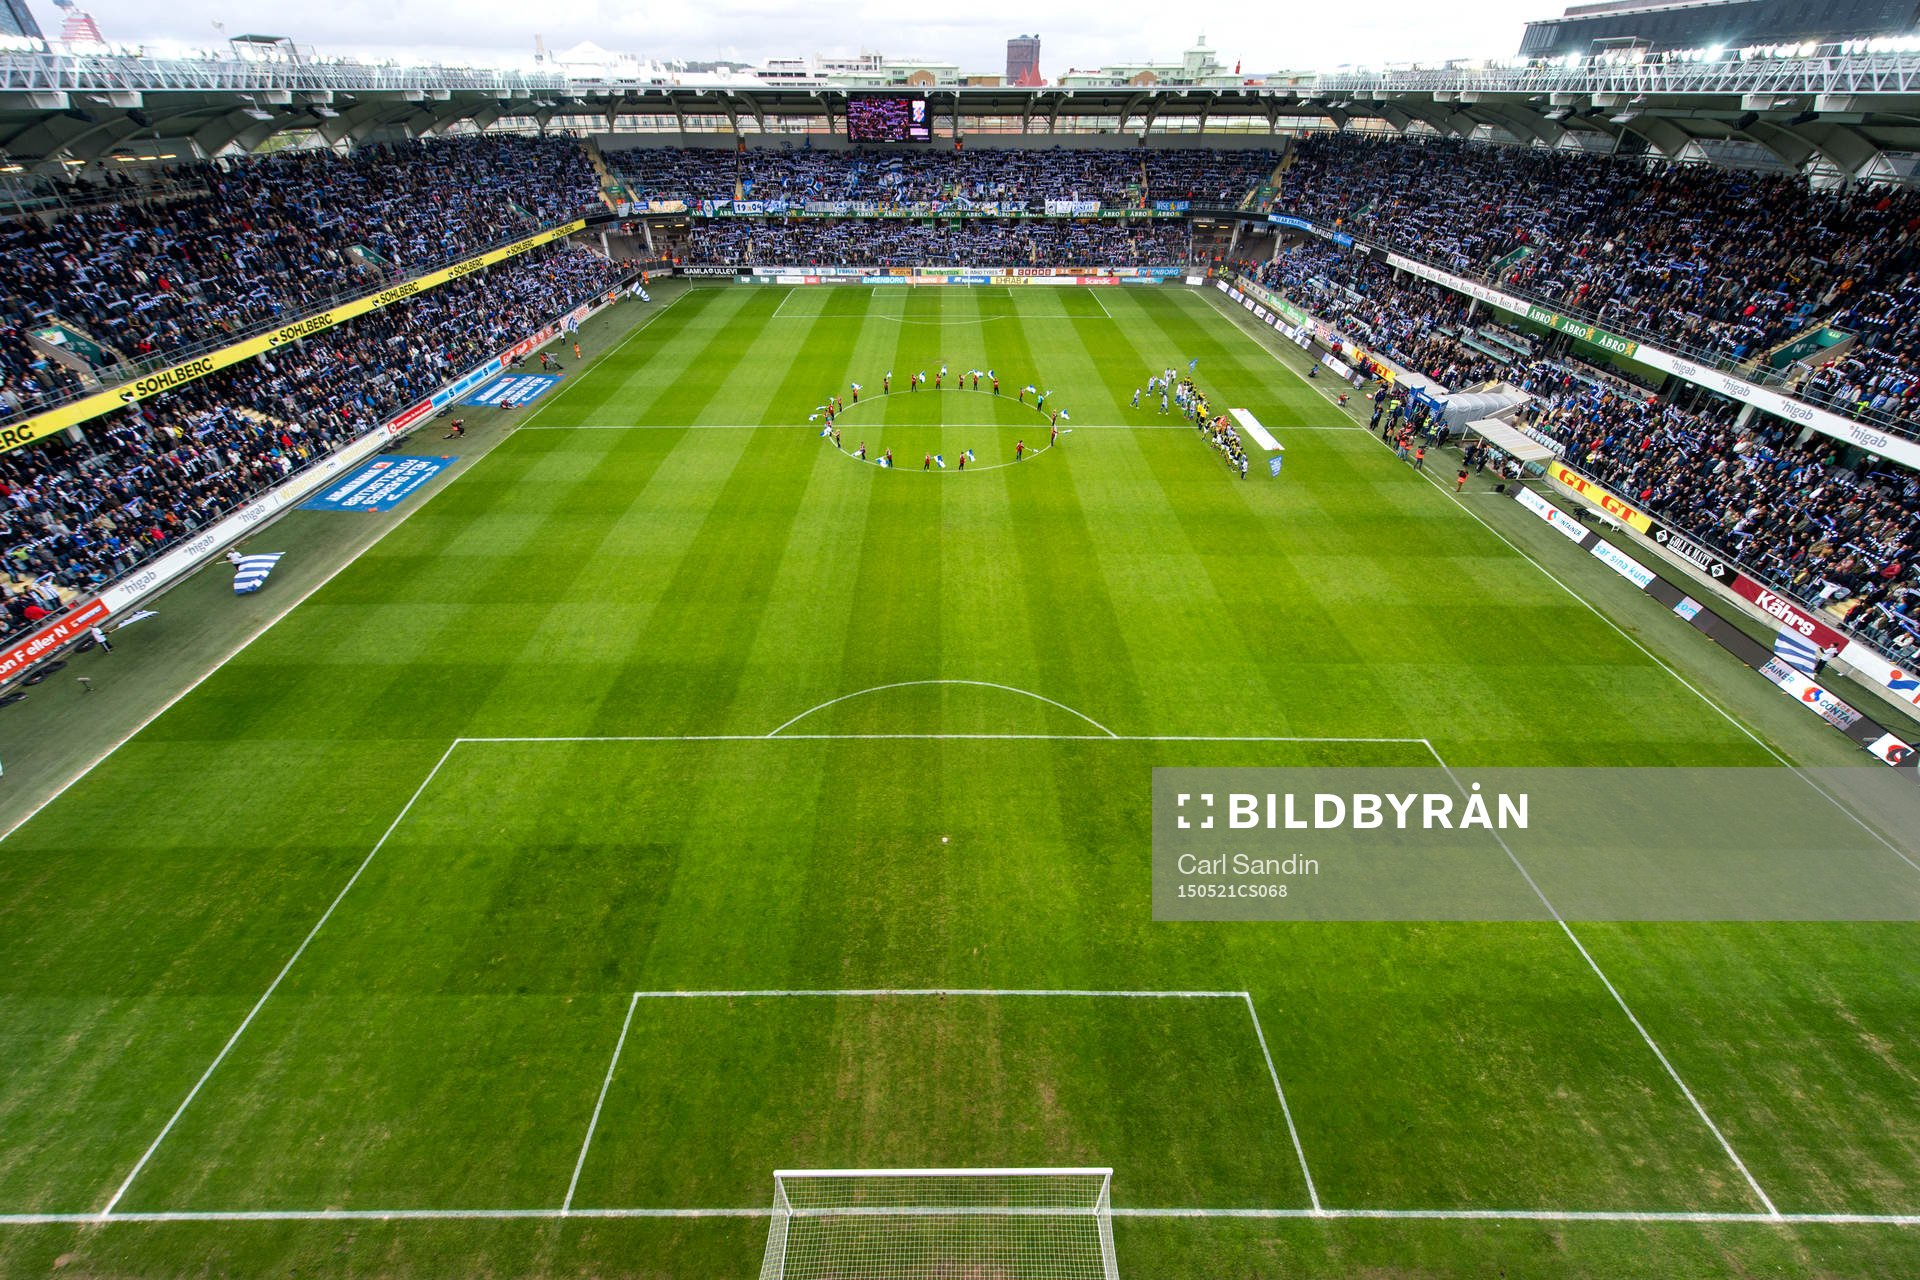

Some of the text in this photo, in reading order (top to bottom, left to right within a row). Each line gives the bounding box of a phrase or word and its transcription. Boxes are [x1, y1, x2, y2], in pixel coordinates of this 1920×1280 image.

[738, 203, 762, 211] 19 04
[555, 223, 576, 237] SOHLBERG
[510, 239, 535, 255] SOHLBERG
[453, 257, 485, 277] SOHLBERG
[1138, 268, 1179, 276] EHENBORG
[863, 276, 904, 284] EHRENBORG
[1085, 277, 1111, 285] Scandic
[379, 282, 420, 305] SOHLBERG
[280, 314, 333, 343] SOHLBERG
[136, 358, 214, 397] SOHLBERG
[1673, 360, 1697, 377] higab
[1724, 379, 1751, 397] higab
[1783, 401, 1814, 421] higab
[1852, 426, 1888, 449] higab
[340, 459, 420, 505] FOTBOLLSKLUBB
[1559, 469, 1591, 494] GT
[241, 503, 266, 523] higab
[1601, 495, 1636, 523] GT
[1559, 519, 1582, 536] NTAINER
[187, 534, 215, 556] higab
[1668, 535, 1688, 554] GOLV
[1686, 548, 1694, 556] &
[1691, 550, 1713, 568] MATT
[1595, 544, 1610, 557] sar
[1609, 555, 1629, 571] sina
[125, 570, 157, 597] higab
[1755, 590, 1815, 637] Kährs
[26, 633, 56, 655] eller
[53, 624, 69, 638] N
[1765, 661, 1795, 682] TAINER
